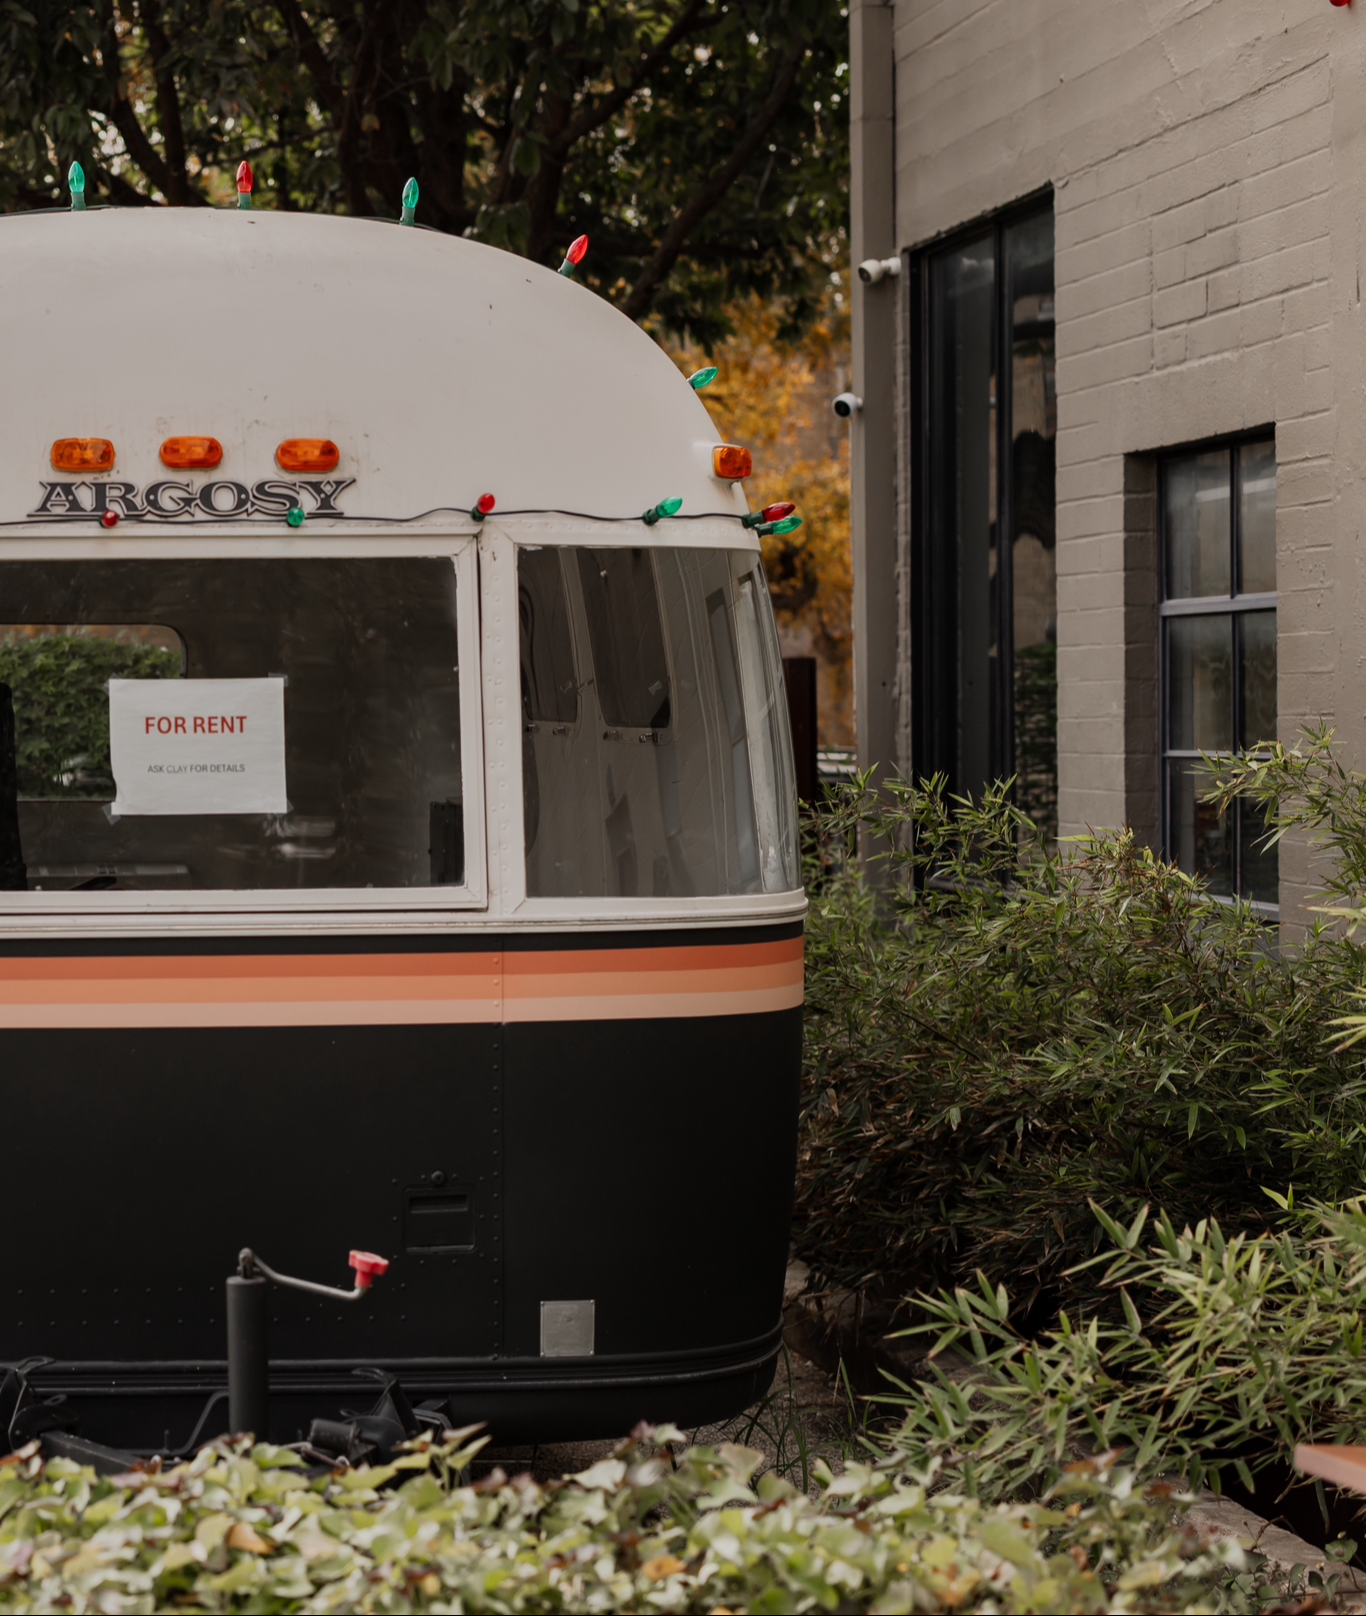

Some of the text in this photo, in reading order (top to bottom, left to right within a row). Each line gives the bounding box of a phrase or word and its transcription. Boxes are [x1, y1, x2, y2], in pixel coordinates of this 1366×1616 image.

[27, 478, 356, 517] ARGOSY
[144, 715, 248, 735] FOR RENT
[147, 763, 246, 774] ASK CLAY FOR DETAILS
